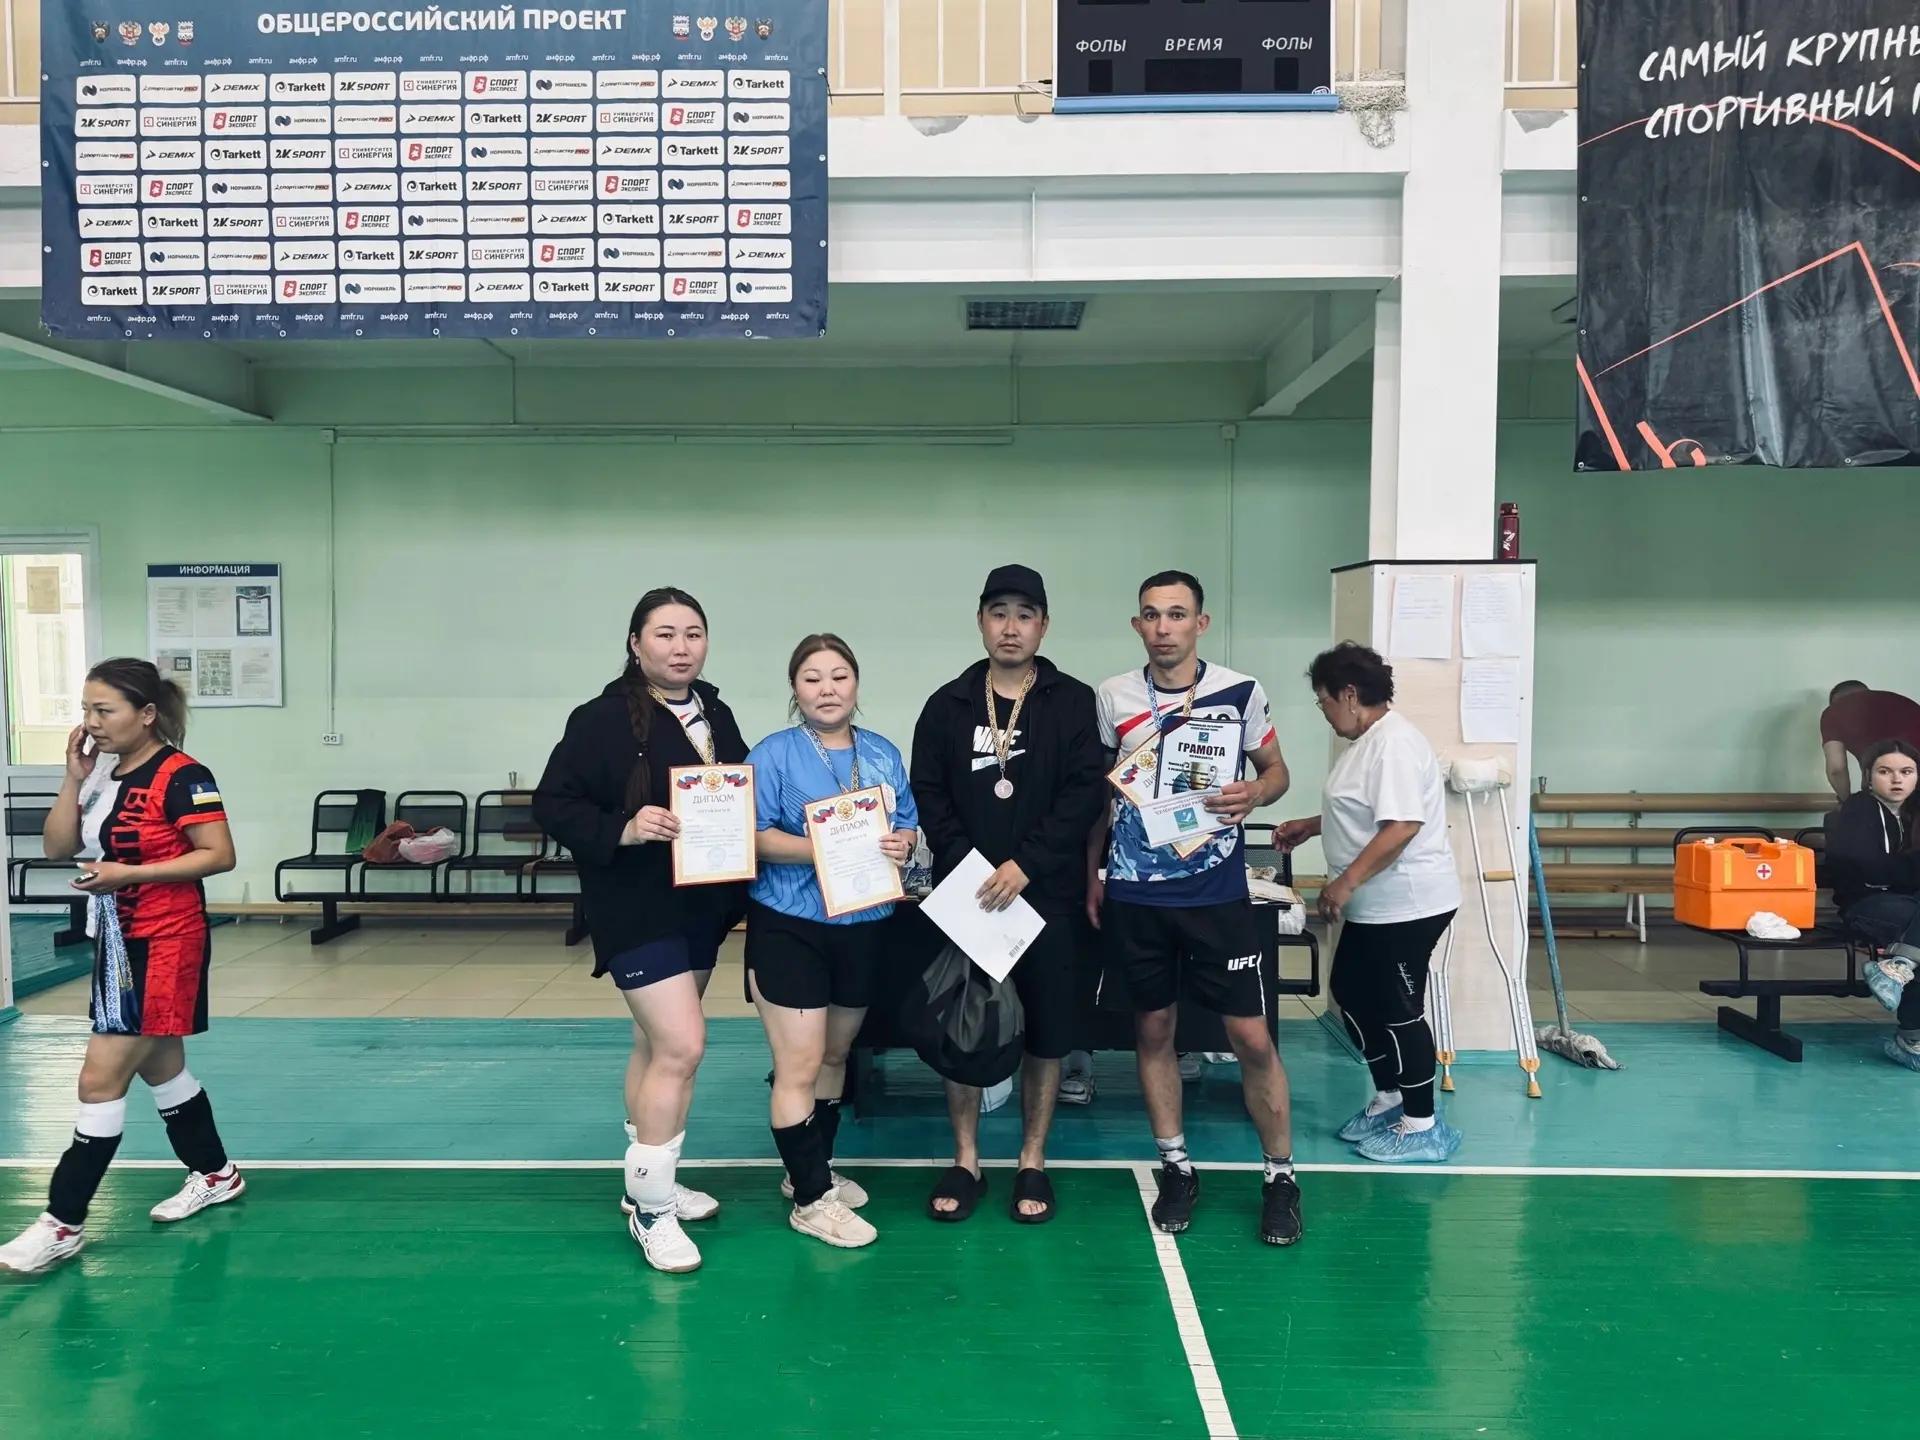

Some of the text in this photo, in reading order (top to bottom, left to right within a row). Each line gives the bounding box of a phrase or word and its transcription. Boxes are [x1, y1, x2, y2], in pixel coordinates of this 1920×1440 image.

[257, 4, 627, 37] ОБЩЕРОССИЙСКИЙ ПРОЕКТ
[1075, 39, 1127, 53] ФОЛЫ
[1164, 37, 1224, 52] ВРЕМЯ
[1261, 36, 1313, 51] ФОЛЫ
[1638, 29, 1767, 82] САМЫЙ
[489, 78, 519, 86] СПОРТ
[679, 80, 719, 88] DEMIX
[745, 78, 785, 89] Tarkett
[222, 84, 261, 92] DEMIX
[287, 82, 326, 93] Tarkett
[356, 82, 391, 92] SPORT
[415, 84, 458, 92] СИНЕРГИЯ
[1644, 75, 1894, 139] СПОРТИВНЫЙ
[228, 114, 259, 122] СПОРТ
[482, 113, 523, 124] Tarkett
[686, 110, 716, 118] СПОРТ
[97, 118, 132, 128] SPORT
[417, 115, 456, 123] DEMIX
[552, 114, 588, 124] SPORT
[612, 116, 654, 124] СИНЕРГИЯ
[155, 120, 197, 128] СИНЕРГИЯ
[424, 145, 454, 153] СПОРТ
[613, 147, 653, 155] DEMIX
[679, 143, 720, 156] Tarkett
[750, 146, 785, 156] SPORT
[158, 151, 197, 159] DEMIX
[222, 149, 262, 160] Tarkett
[291, 150, 327, 159] SPORT
[351, 151, 393, 160] СИНЕРГИЯ
[165, 181, 195, 190] СПОРТ
[418, 180, 458, 192] Tarkett
[620, 177, 651, 186] СПОРТ
[92, 187, 134, 196] СИНЕРГИЯ
[353, 183, 393, 191] DEMIX
[487, 182, 523, 193] SPORT
[547, 184, 589, 192] СИНЕРГИЯ
[360, 214, 391, 222] СПОРТ
[549, 215, 588, 223] DEMIX
[614, 213, 655, 225] Tarkett
[685, 215, 720, 225] SPORT
[753, 211, 784, 220] СПОРТ
[95, 219, 134, 227] DEMIX
[158, 217, 199, 228] Tarkett
[229, 218, 264, 228] SPORT
[288, 220, 330, 228] СИНЕРГИЯ
[104, 249, 133, 258] СПОРТ
[356, 250, 396, 261] Tarkett
[424, 251, 460, 260] SPORT
[557, 247, 586, 255] СПОРТ
[747, 251, 787, 259] DEMIX
[291, 252, 330, 261] DEMIX
[483, 253, 525, 261] СИНЕРГИЯ
[298, 280, 328, 289] СПОРТ
[486, 283, 524, 291] DEMIX
[551, 281, 590, 293] Tarkett
[621, 283, 656, 293] SPORT
[688, 280, 719, 288] СПОРТ
[99, 286, 138, 297] Tarkett
[168, 286, 201, 296] SPORT
[179, 564, 251, 576] ИНФОРМАЦИЯ
[1177, 741, 1226, 757] ГРАМОТА
[692, 793, 735, 805] ДИПЛОМ
[829, 818, 870, 836] ДИПЛОМ
[1227, 954, 1257, 971] UFC
